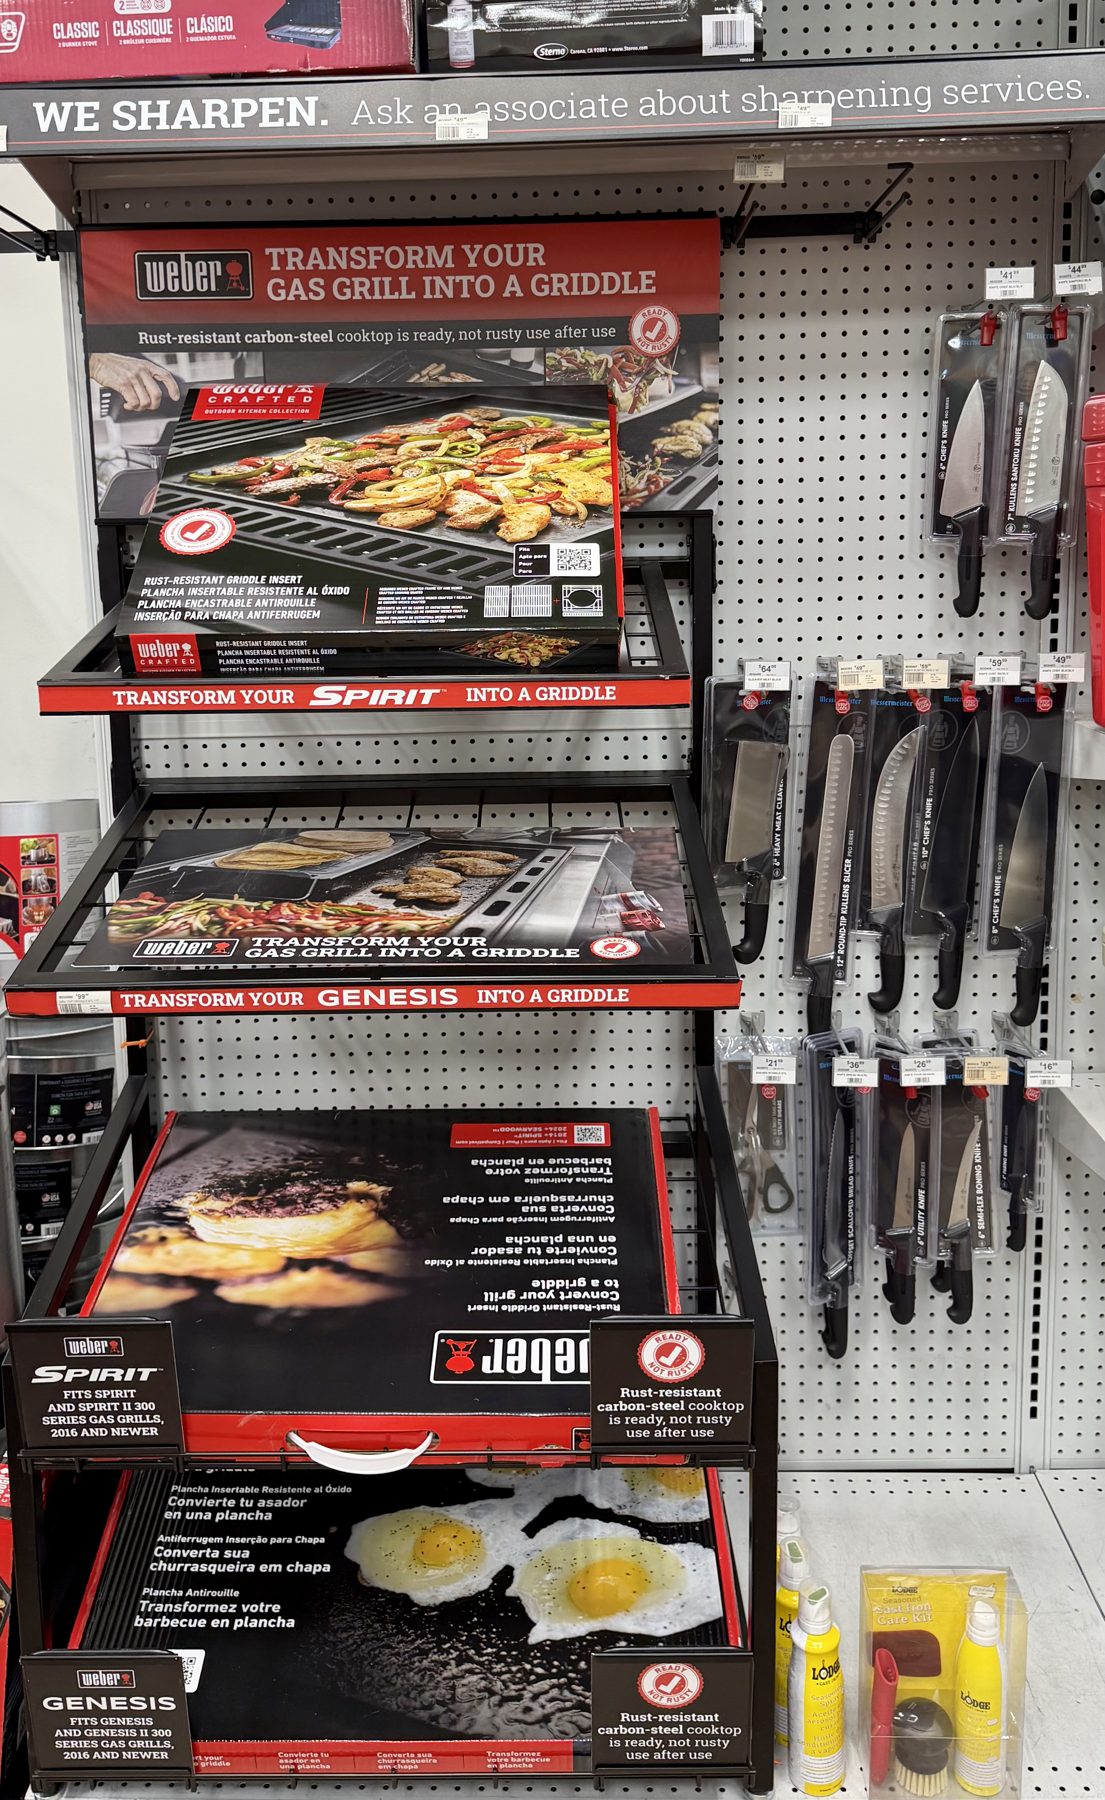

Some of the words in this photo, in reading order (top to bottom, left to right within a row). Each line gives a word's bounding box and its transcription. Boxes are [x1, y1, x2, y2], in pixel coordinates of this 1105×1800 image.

[53, 21, 99, 39] CLASSIC
[113, 18, 173, 37] CLASSIQUE
[187, 14, 233, 33] CLÁSICO
[540, 47, 565, 56] Sterno
[33, 100, 100, 133] WE
[112, 97, 328, 132] SHARPEN.
[351, 99, 412, 126] Ask
[475, 91, 628, 121] associate
[639, 86, 732, 115] about
[943, 75, 1091, 105] services.
[144, 253, 222, 292] weber
[265, 245, 454, 271] TRANSFORM
[462, 243, 546, 268] YOUR
[267, 278, 326, 301] GAS
[332, 276, 415, 300] GRILL
[423, 275, 495, 298] INTO
[503, 274, 523, 297] A
[530, 270, 657, 296] GRIDDLE
[640, 309, 668, 320] READY
[138, 331, 241, 345] Rust-resistant
[245, 329, 333, 343] carbon-steel
[336, 329, 393, 346] cooktop
[397, 329, 410, 342] is
[414, 328, 455, 344] ready,
[459, 328, 482, 341] not
[486, 328, 521, 343] rusty
[526, 329, 551, 339] use
[555, 326, 588, 338] after
[592, 326, 616, 337] use
[636, 337, 650, 350] NOT
[651, 335, 674, 351] RUSTY
[1014, 427, 1022, 446] KNIFE
[1011, 449, 1020, 482] SANTOKU
[144, 576, 224, 586] RUST-RESISTANT
[226, 576, 266, 584] GRIDDLE
[268, 575, 302, 584] INSERT
[140, 588, 185, 597] PLANCHA
[188, 587, 244, 596] INSERTABLE
[248, 587, 304, 596] RESISTENTE
[306, 587, 319, 595] AL
[322, 584, 350, 595] ÓXIDO
[137, 600, 182, 608] PLANCHA
[184, 599, 252, 608] ENCASTRABLE
[254, 598, 316, 607] ANTIROUILLE
[134, 609, 182, 622] INSERÇÃO
[184, 611, 210, 620] PARA
[212, 610, 244, 620] CHAPA
[247, 610, 320, 619] ANTIFERRUGEM
[137, 640, 180, 658] weber
[113, 689, 240, 706] TRANSFORM
[242, 690, 295, 704] YOUR
[466, 687, 512, 702] INTO
[518, 687, 531, 701] A
[536, 686, 616, 701] GRIDDLE
[923, 820, 931, 844] CHEF'S
[844, 858, 852, 881] SLICER
[841, 884, 850, 914] KULLENS
[838, 916, 848, 954] ROUND-TIP
[143, 940, 212, 955] weber
[252, 936, 412, 947] TRANSFORM
[416, 936, 488, 946] YOUR
[245, 947, 291, 958] GAS
[302, 948, 374, 958] GRILL
[378, 948, 445, 957] INTO
[446, 948, 464, 957] A
[472, 948, 580, 957] GRIDDLE
[120, 992, 244, 1008] TRANSFORM
[248, 992, 304, 1006] YOUR
[317, 988, 458, 1007] GENESIS
[477, 989, 526, 1004] INTO
[529, 990, 544, 1002] A
[547, 988, 630, 1002] GRIDDLE
[532, 1278, 587, 1289] griddle
[604, 1280, 619, 1288] to
[484, 1290, 515, 1302] grill
[520, 1289, 556, 1301] your
[559, 1290, 620, 1301] Convert
[69, 1338, 108, 1354] weber
[63, 1390, 92, 1399] FITS
[95, 1390, 136, 1398] SPIRIT
[48, 1403, 76, 1412] AND
[78, 1402, 120, 1412] SPIRIT
[122, 1402, 133, 1411] II
[134, 1402, 155, 1410] 300
[42, 1416, 86, 1425] SERIES
[89, 1416, 114, 1424] GAS
[116, 1415, 164, 1426] GRILLS,
[51, 1428, 78, 1438] 2016
[80, 1428, 108, 1437] AND
[111, 1428, 159, 1436] NEWER
[139, 1601, 236, 1612] Transformez
[242, 1602, 280, 1612] votre
[134, 1616, 206, 1628] barbecue
[211, 1618, 230, 1628] en
[234, 1616, 295, 1630] plancha
[82, 1671, 120, 1686] weber
[42, 1696, 177, 1711] GENESIS
[70, 1718, 98, 1726] FITS
[100, 1717, 154, 1726] GENESIS
[54, 1729, 82, 1737] AND
[84, 1729, 137, 1737] GENESIS
[140, 1729, 148, 1737] II
[151, 1729, 172, 1737] 300
[55, 1740, 99, 1749] SERIES
[100, 1740, 126, 1748] GAS
[128, 1740, 174, 1750] GRILLS,
[64, 1752, 90, 1760] 2016
[93, 1752, 119, 1760] AND
[122, 1752, 168, 1760] NEWER
